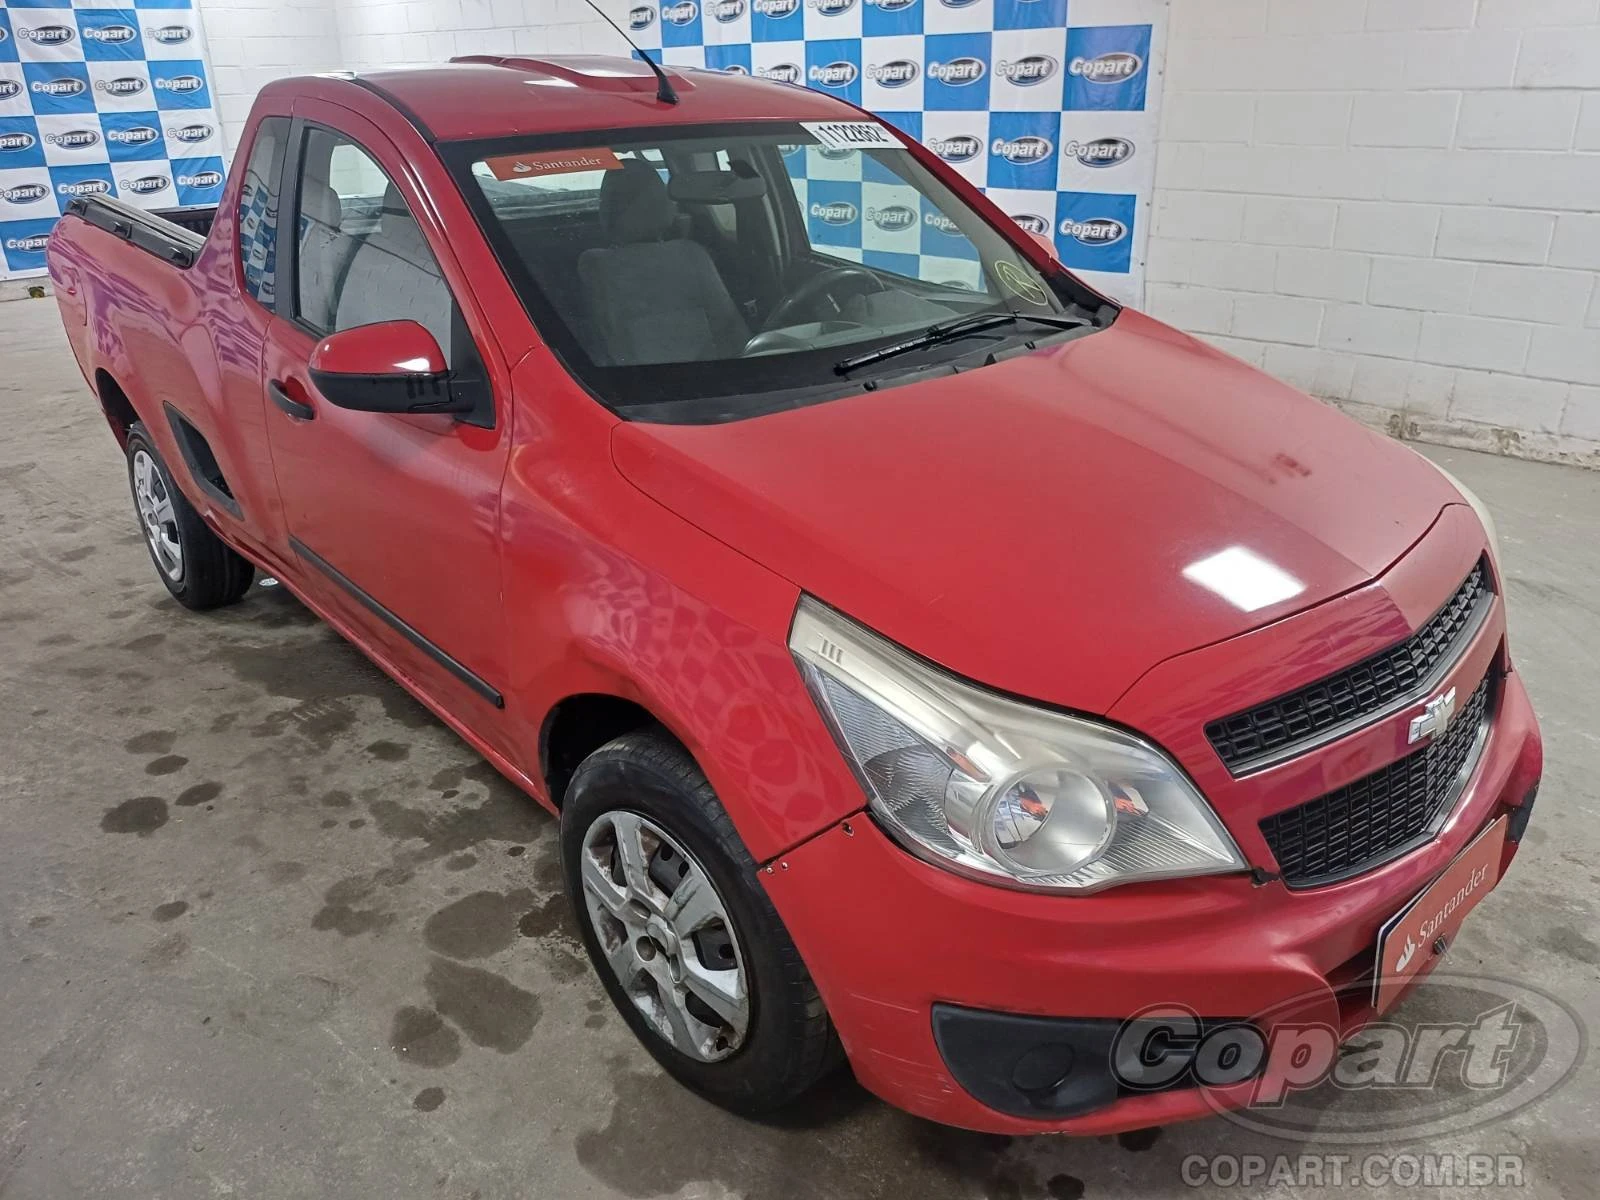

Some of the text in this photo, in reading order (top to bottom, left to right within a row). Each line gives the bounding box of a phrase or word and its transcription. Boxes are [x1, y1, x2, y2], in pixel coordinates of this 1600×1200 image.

[661, 5, 695, 22] Copart
[704, 0, 741, 17] Copart
[753, 0, 793, 14] Copart
[630, 9, 650, 24] part
[18, 26, 69, 40] Copart
[83, 27, 131, 40] Copart
[146, 27, 189, 40] Copart
[809, 64, 852, 83] Copart
[866, 64, 913, 81] Copart
[927, 61, 982, 79] Copart
[995, 60, 1049, 79] Copart
[1069, 57, 1133, 77] Copart
[32, 80, 81, 94] Copart
[95, 79, 141, 93] Copart
[155, 76, 201, 91] Copart
[45, 130, 94, 147] Copart
[107, 128, 153, 144] Copart
[167, 126, 211, 141] Copart
[0, 137, 28, 149] part
[927, 137, 976, 157] Copart
[991, 138, 1045, 160] Copart
[1065, 140, 1125, 161] Copart
[533, 157, 601, 170] Santander
[58, 181, 105, 197] Copart
[119, 176, 164, 193] Copart
[177, 173, 219, 188] Copart
[811, 202, 852, 220] Copart
[865, 207, 910, 225] Copart
[924, 213, 960, 230] Copa
[1059, 218, 1118, 241] Copart
[6, 237, 48, 250] Copar
[1417, 861, 1489, 950] Santander
